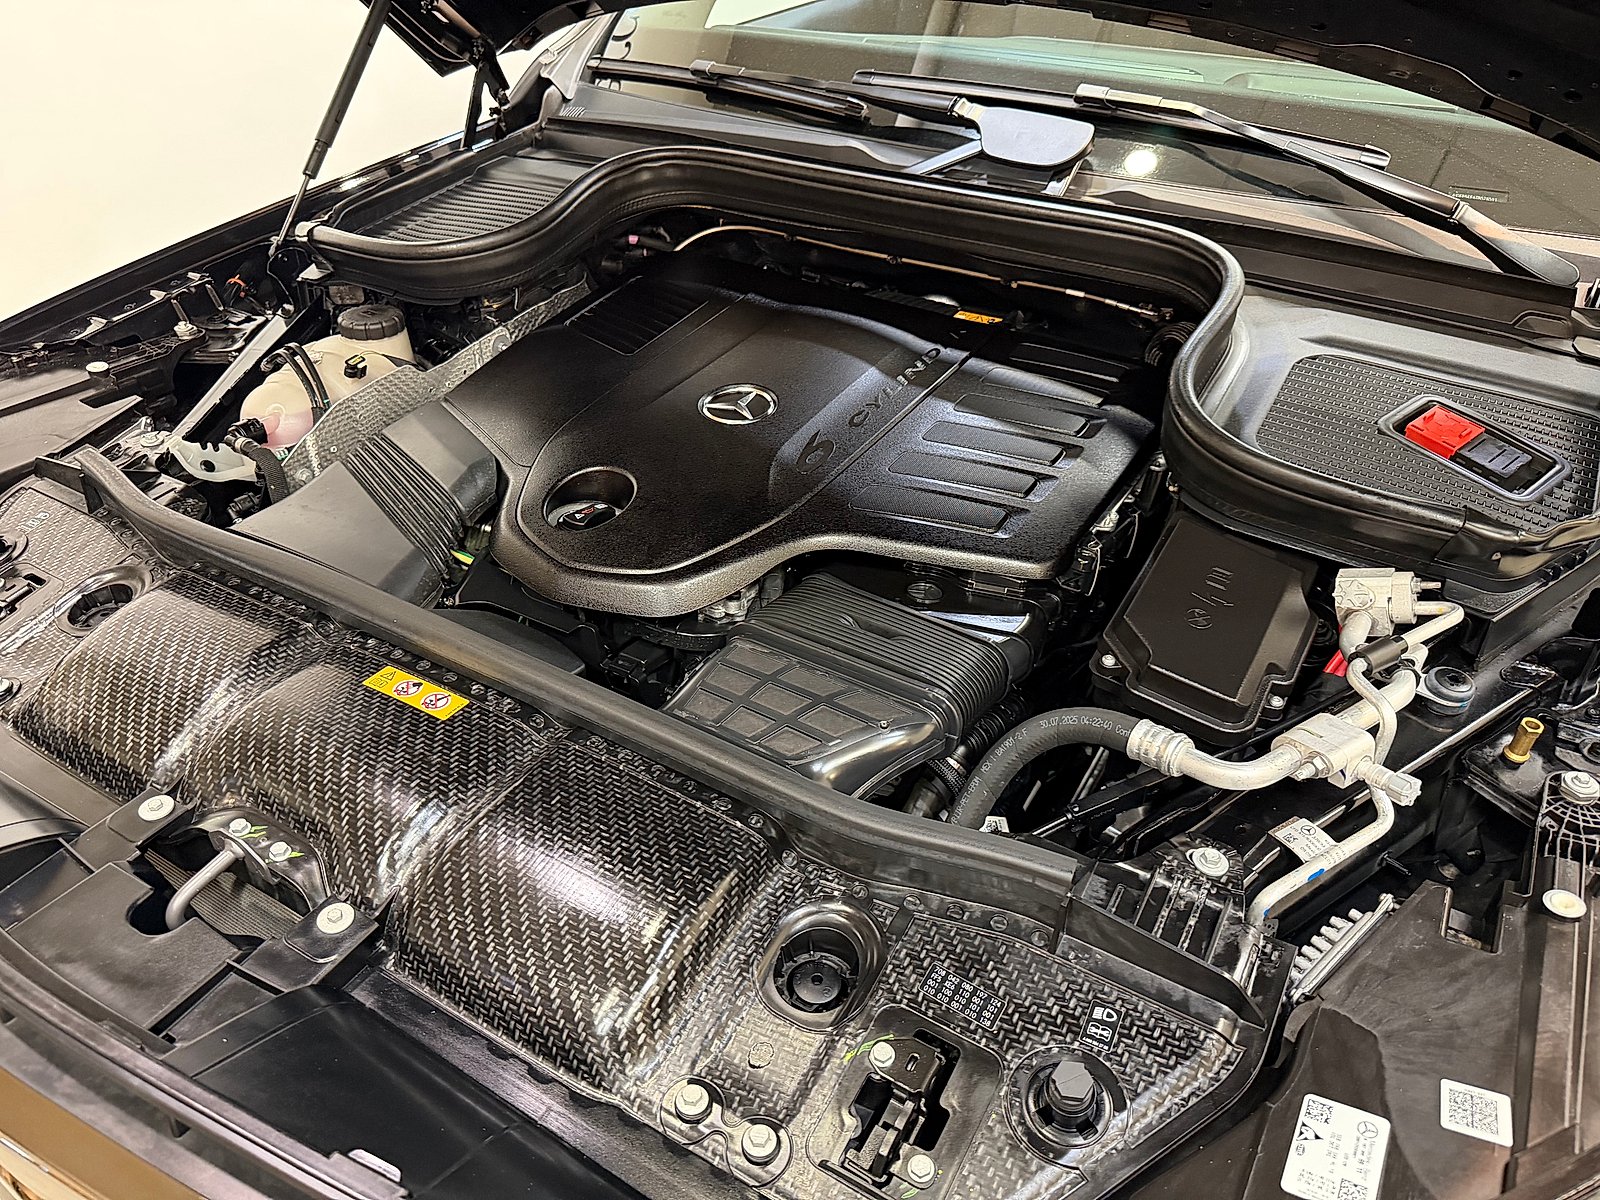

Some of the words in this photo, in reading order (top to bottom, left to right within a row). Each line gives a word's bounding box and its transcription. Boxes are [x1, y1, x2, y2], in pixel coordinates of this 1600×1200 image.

[794, 429, 836, 475] 6
[1039, 715, 1079, 729] 30.07.2025
[923, 985, 936, 995] 010
[936, 993, 949, 1003] 010
[950, 1000, 963, 1011] 001
[964, 1008, 977, 1019] 010
[926, 979, 939, 989] 001
[941, 987, 953, 997] 100
[954, 994, 967, 1005] 010
[969, 1002, 980, 1012] 101
[982, 1010, 994, 1020] 001
[958, 988, 970, 999] 110
[971, 996, 984, 1006] 001
[986, 1004, 998, 1014] 101
[976, 990, 988, 999] 197
